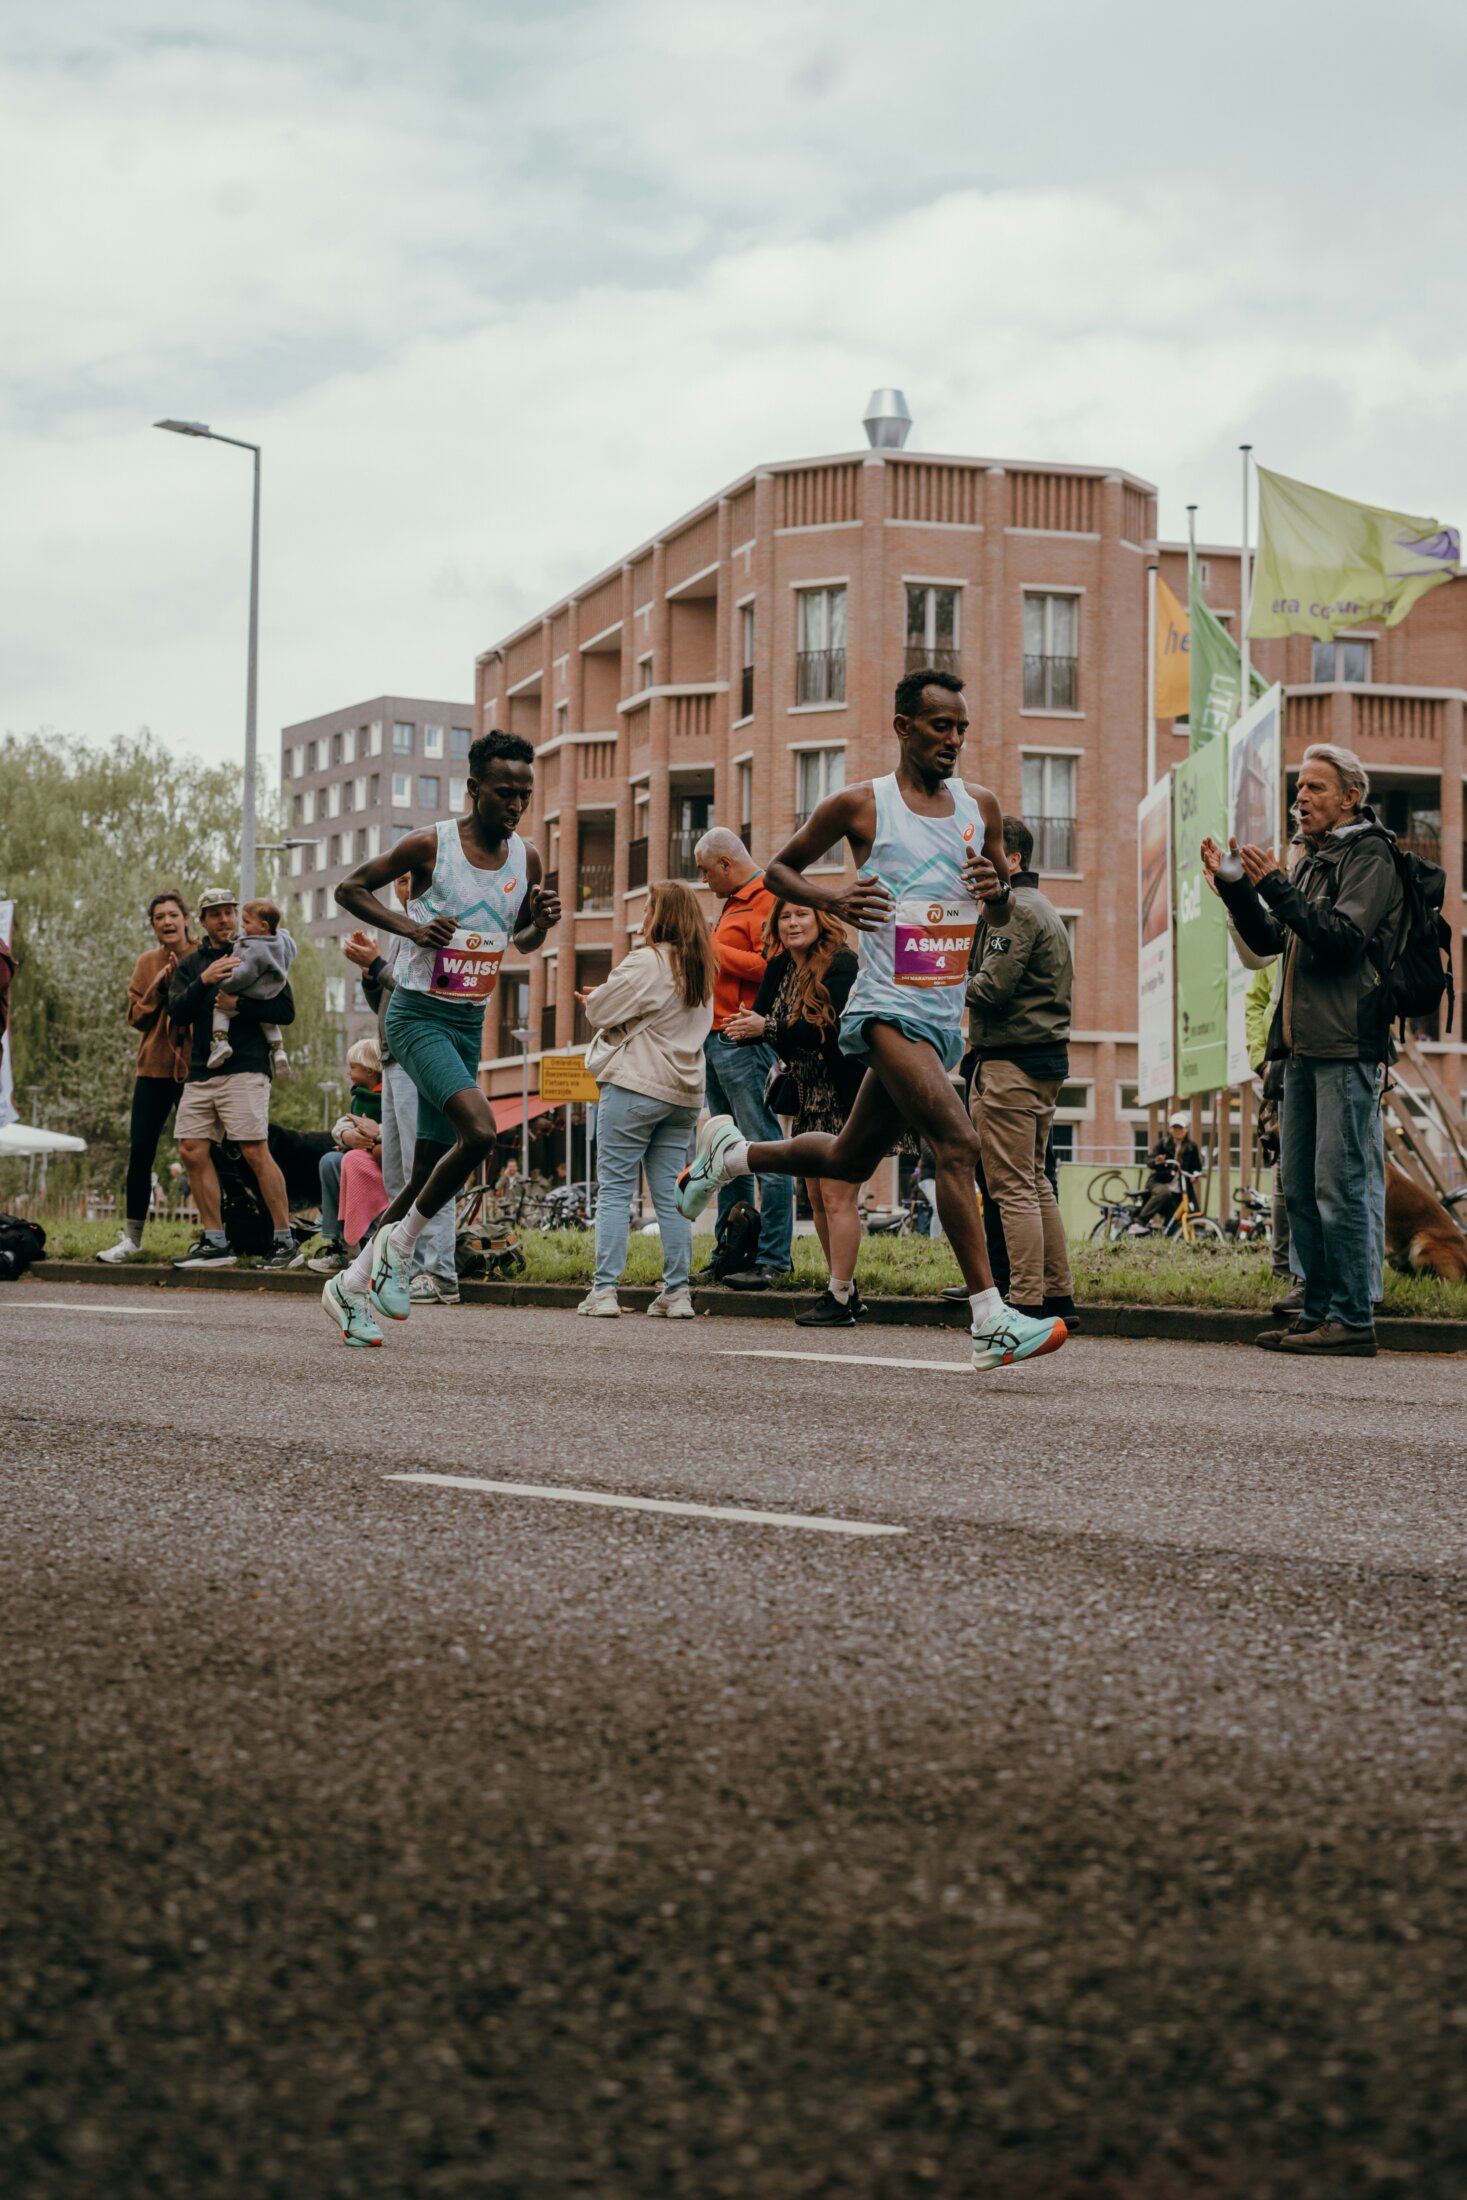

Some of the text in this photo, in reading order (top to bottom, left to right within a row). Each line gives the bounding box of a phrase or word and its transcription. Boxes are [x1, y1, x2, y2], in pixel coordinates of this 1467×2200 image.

[1272, 599, 1299, 614] era
[904, 937, 971, 952] ASMARE
[936, 956, 945, 969] 4
[462, 976, 478, 987] 38
